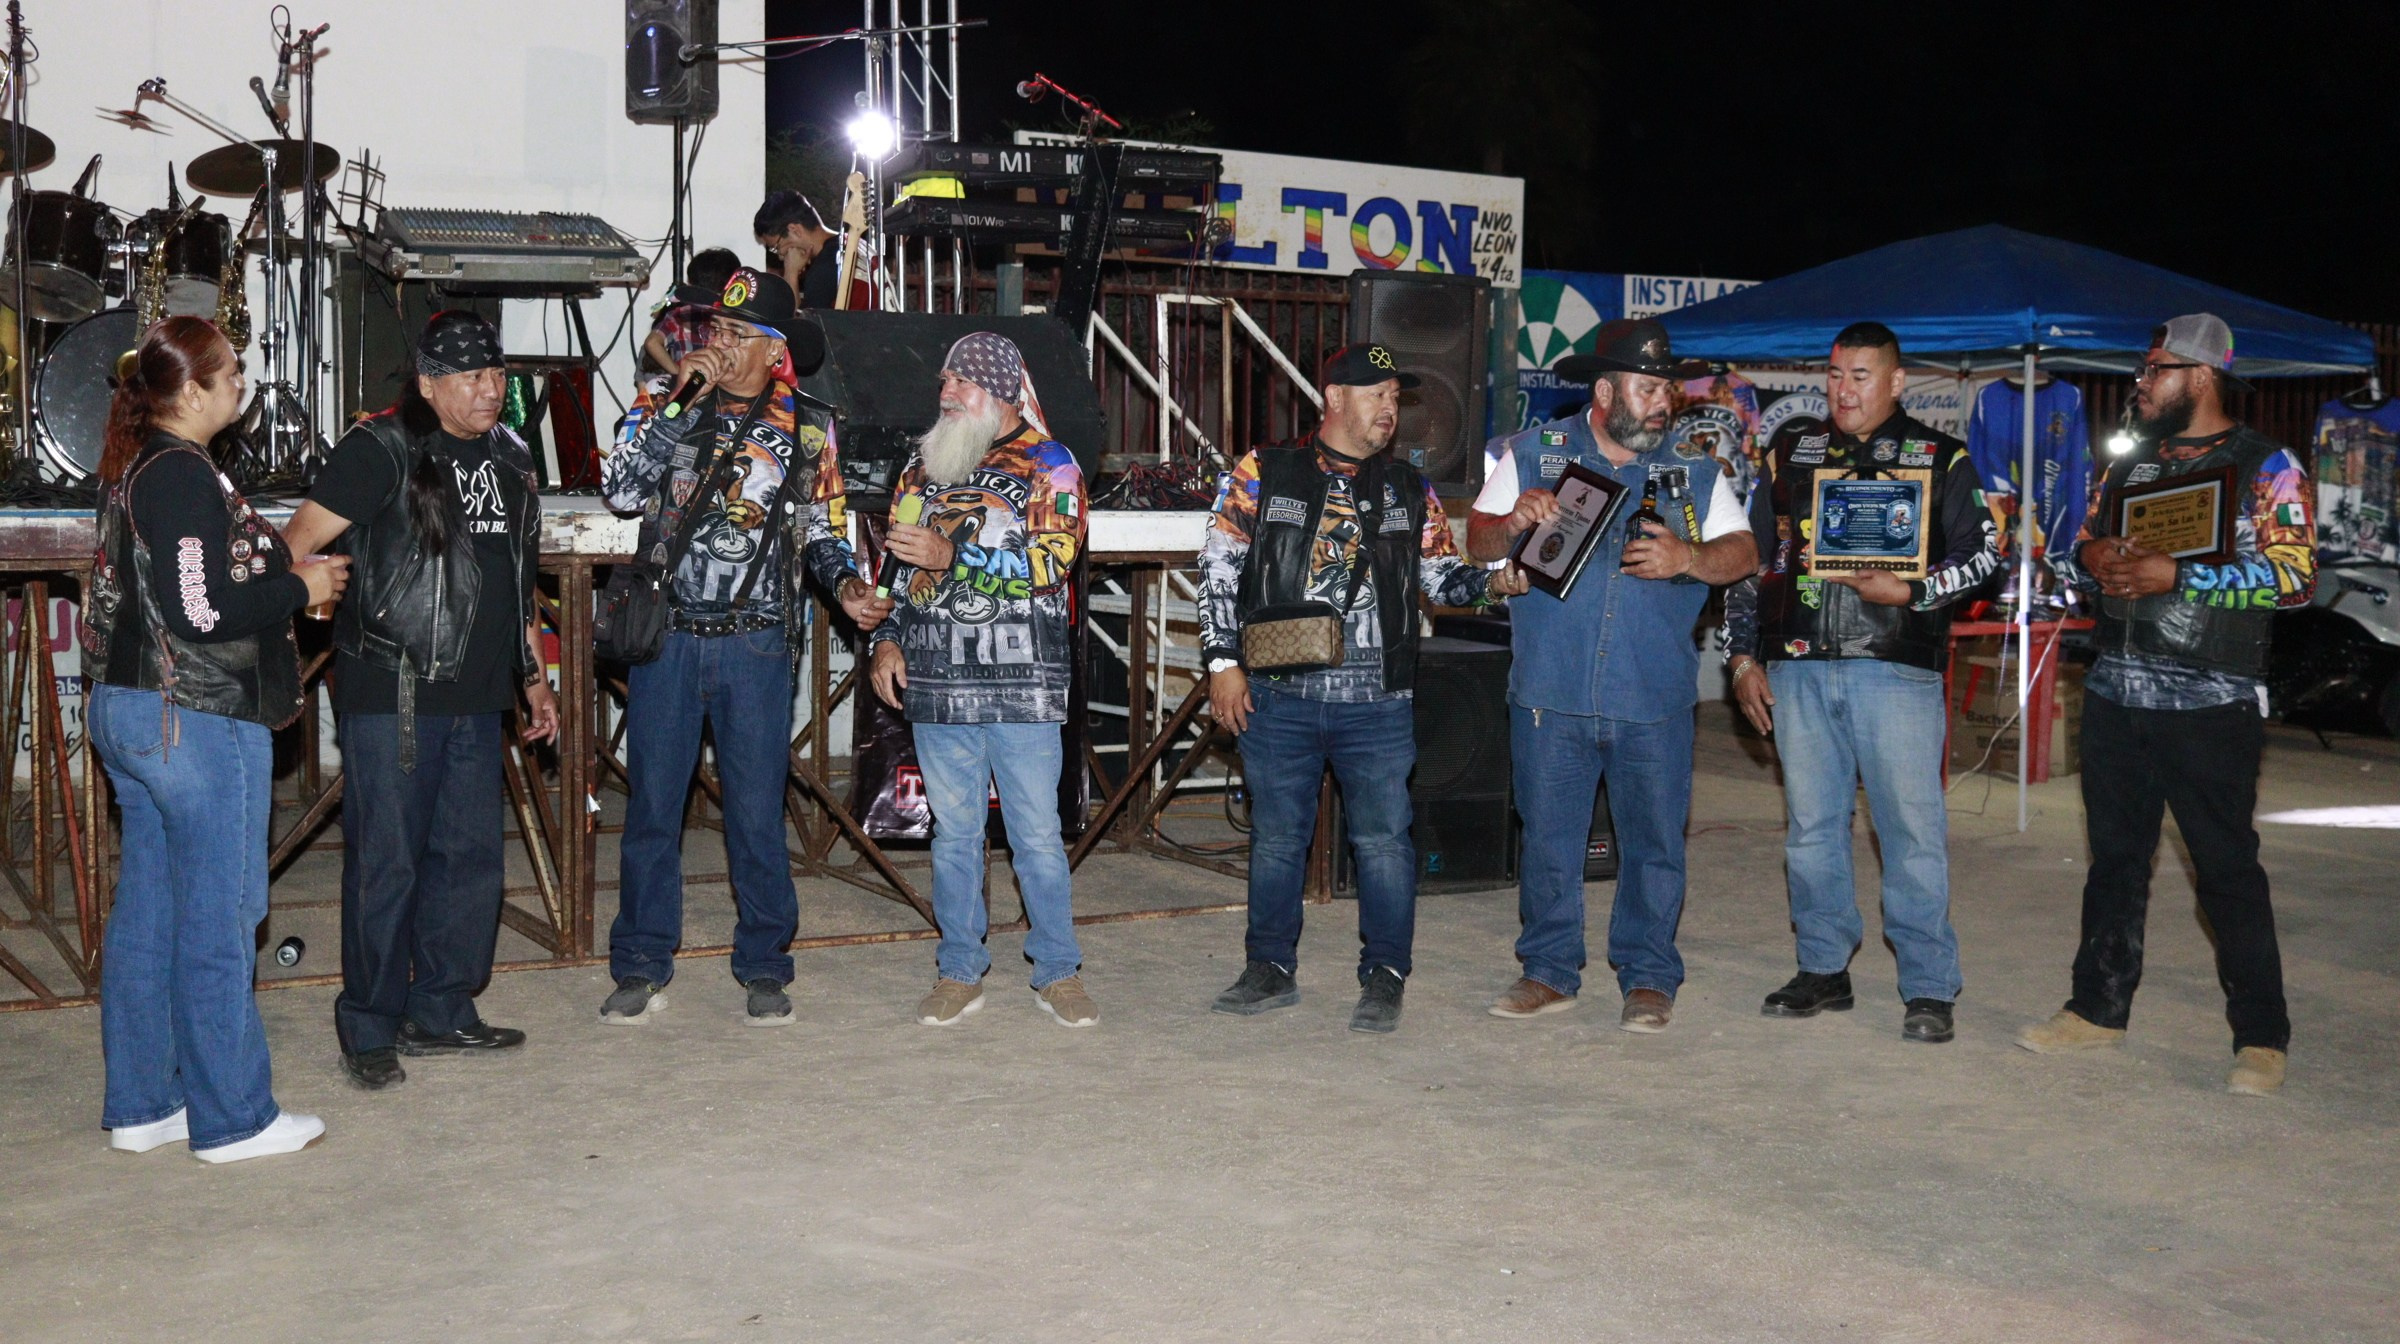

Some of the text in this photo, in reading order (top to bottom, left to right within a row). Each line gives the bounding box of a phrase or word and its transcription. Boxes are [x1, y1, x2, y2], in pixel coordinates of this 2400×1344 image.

[1000, 151, 1031, 173] M1
[1480, 210, 1513, 233] NVO.
[1631, 277, 1752, 307] INSTALA
[1759, 397, 1826, 435] OSOS VIE
[1274, 499, 1303, 509] WILLYS
[475, 521, 491, 534] IN
[1268, 511, 1304, 523] TESORERO
[2189, 563, 2276, 590] SAN
[908, 623, 948, 650] SAN
[948, 665, 1034, 679] COLORADO
